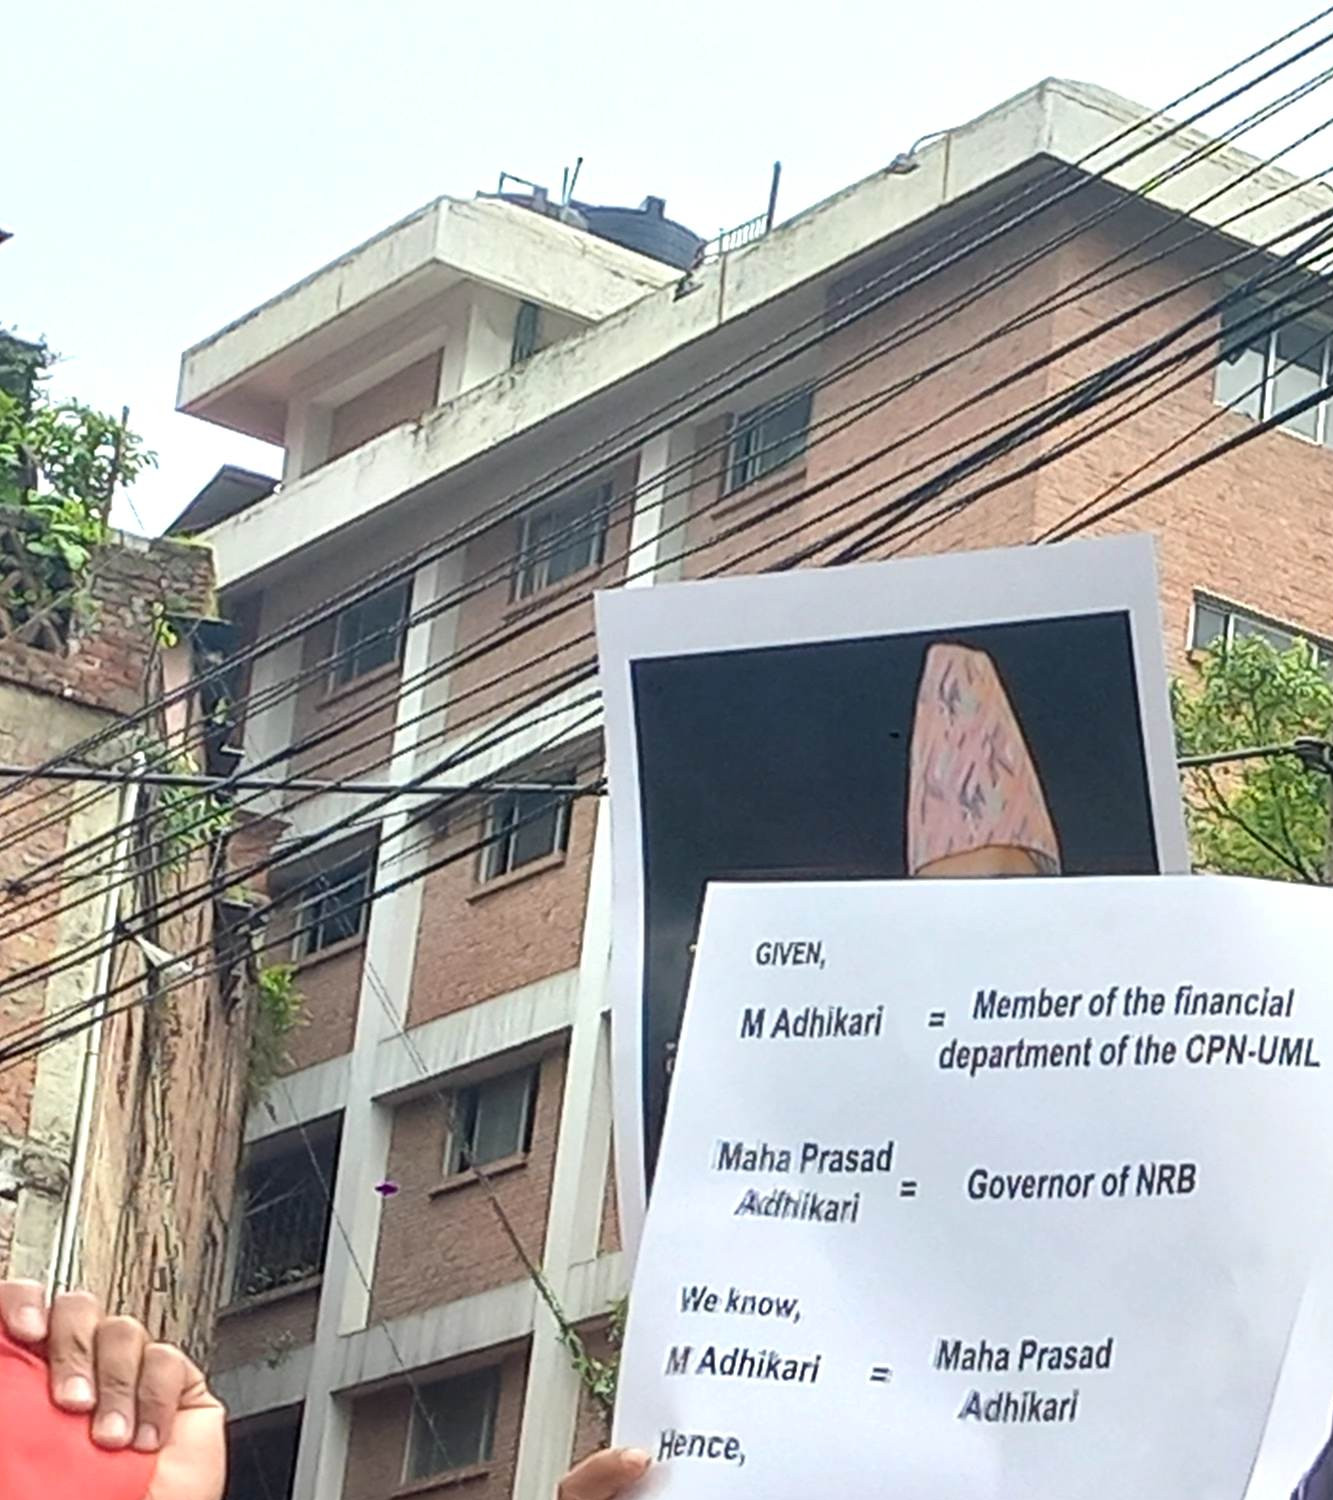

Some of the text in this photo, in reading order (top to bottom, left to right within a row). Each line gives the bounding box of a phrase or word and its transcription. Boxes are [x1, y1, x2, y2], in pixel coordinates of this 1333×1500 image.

[756, 941, 825, 969] GIVEN,
[741, 1008, 766, 1038] M
[770, 1005, 884, 1038] Adhikari
[973, 988, 1082, 1019] Member
[1089, 986, 1119, 1016] of
[1123, 986, 1165, 1016] the
[1174, 985, 1294, 1017] financial
[939, 1034, 1320, 1077] department of the CPN-UML
[718, 1141, 894, 1173] Maha Prasad
[734, 1189, 860, 1223] Adhikari
[968, 1169, 1095, 1199] Governor
[1102, 1165, 1131, 1197] of
[1136, 1163, 1196, 1196] NRB
[682, 1286, 800, 1323] We know,
[665, 1346, 693, 1375] M
[696, 1346, 821, 1383] Adhikari
[936, 1340, 1010, 1372] Maha
[1018, 1338, 1113, 1371] Prasad
[958, 1390, 1079, 1423] Adhikari
[657, 1429, 745, 1466] Hence,
